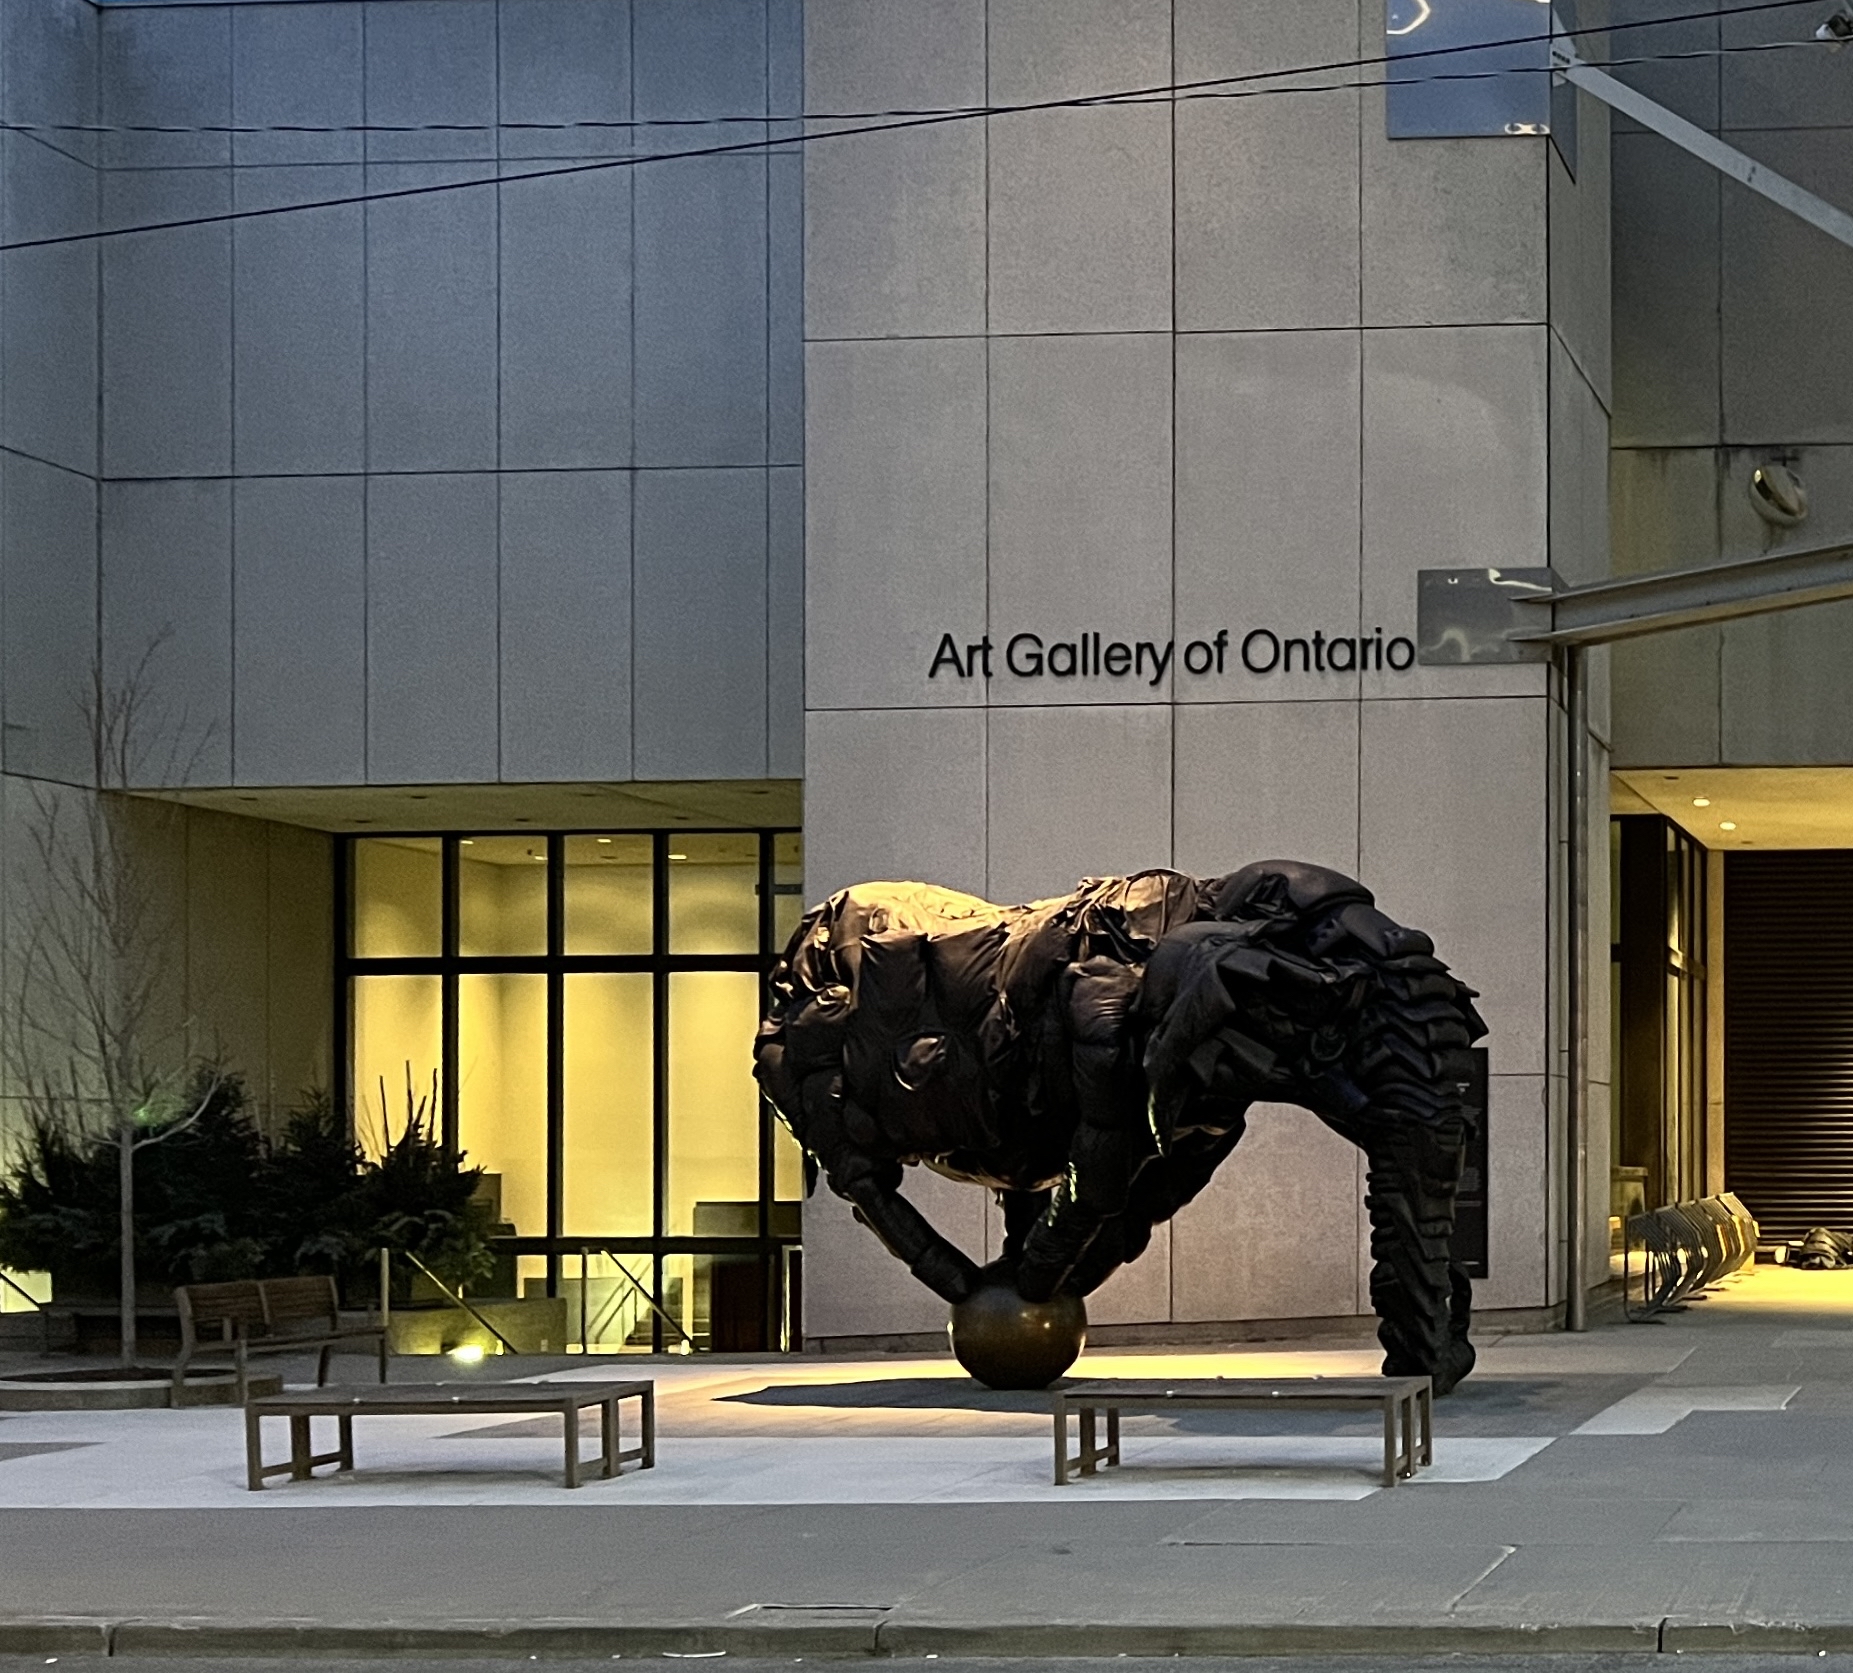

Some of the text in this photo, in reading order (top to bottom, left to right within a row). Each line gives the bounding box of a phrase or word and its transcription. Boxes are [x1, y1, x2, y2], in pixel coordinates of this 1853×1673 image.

[928, 627, 1415, 686] Art Gallery of Ontario
